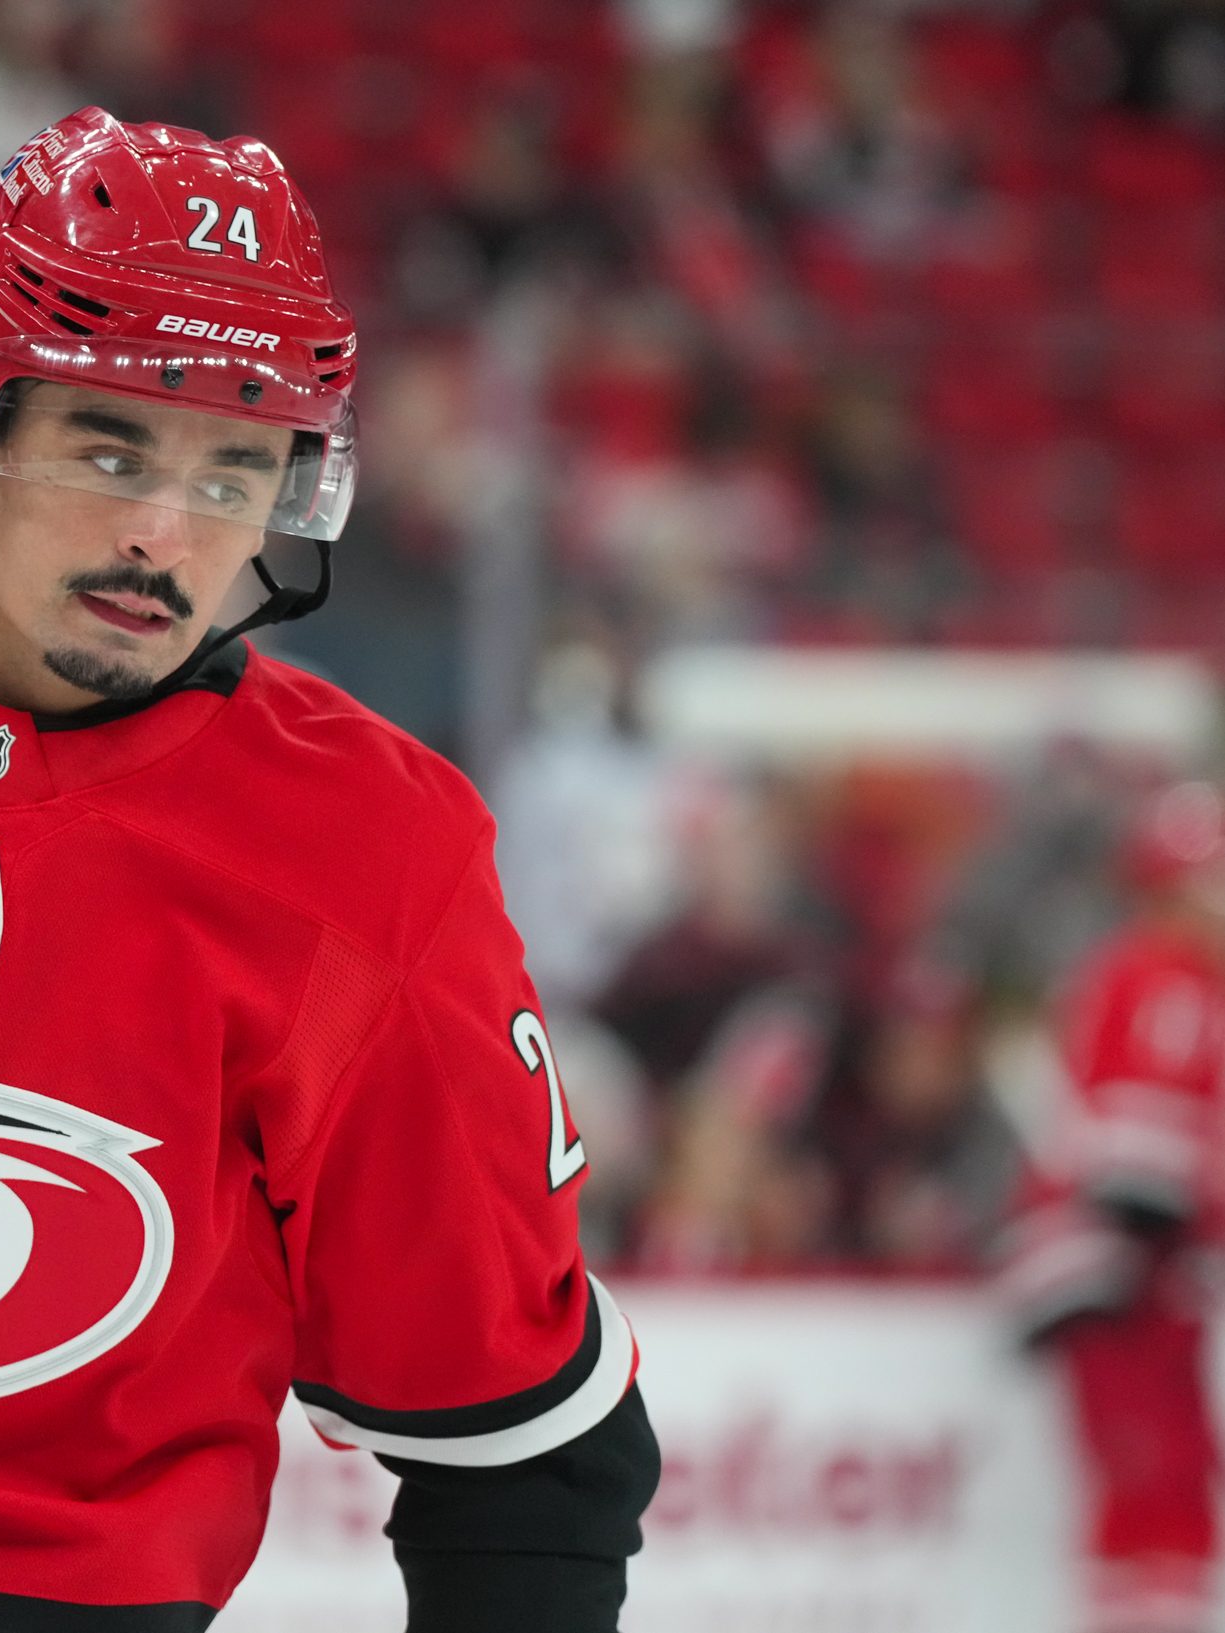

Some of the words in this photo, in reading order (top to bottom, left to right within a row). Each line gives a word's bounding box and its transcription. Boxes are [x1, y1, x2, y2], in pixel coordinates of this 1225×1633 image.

[42, 130, 68, 159] First
[2, 169, 27, 206] Bank
[22, 150, 54, 195] Citizens
[185, 196, 262, 263] 24
[155, 314, 281, 352] BAUER
[509, 1007, 587, 1195] 2
